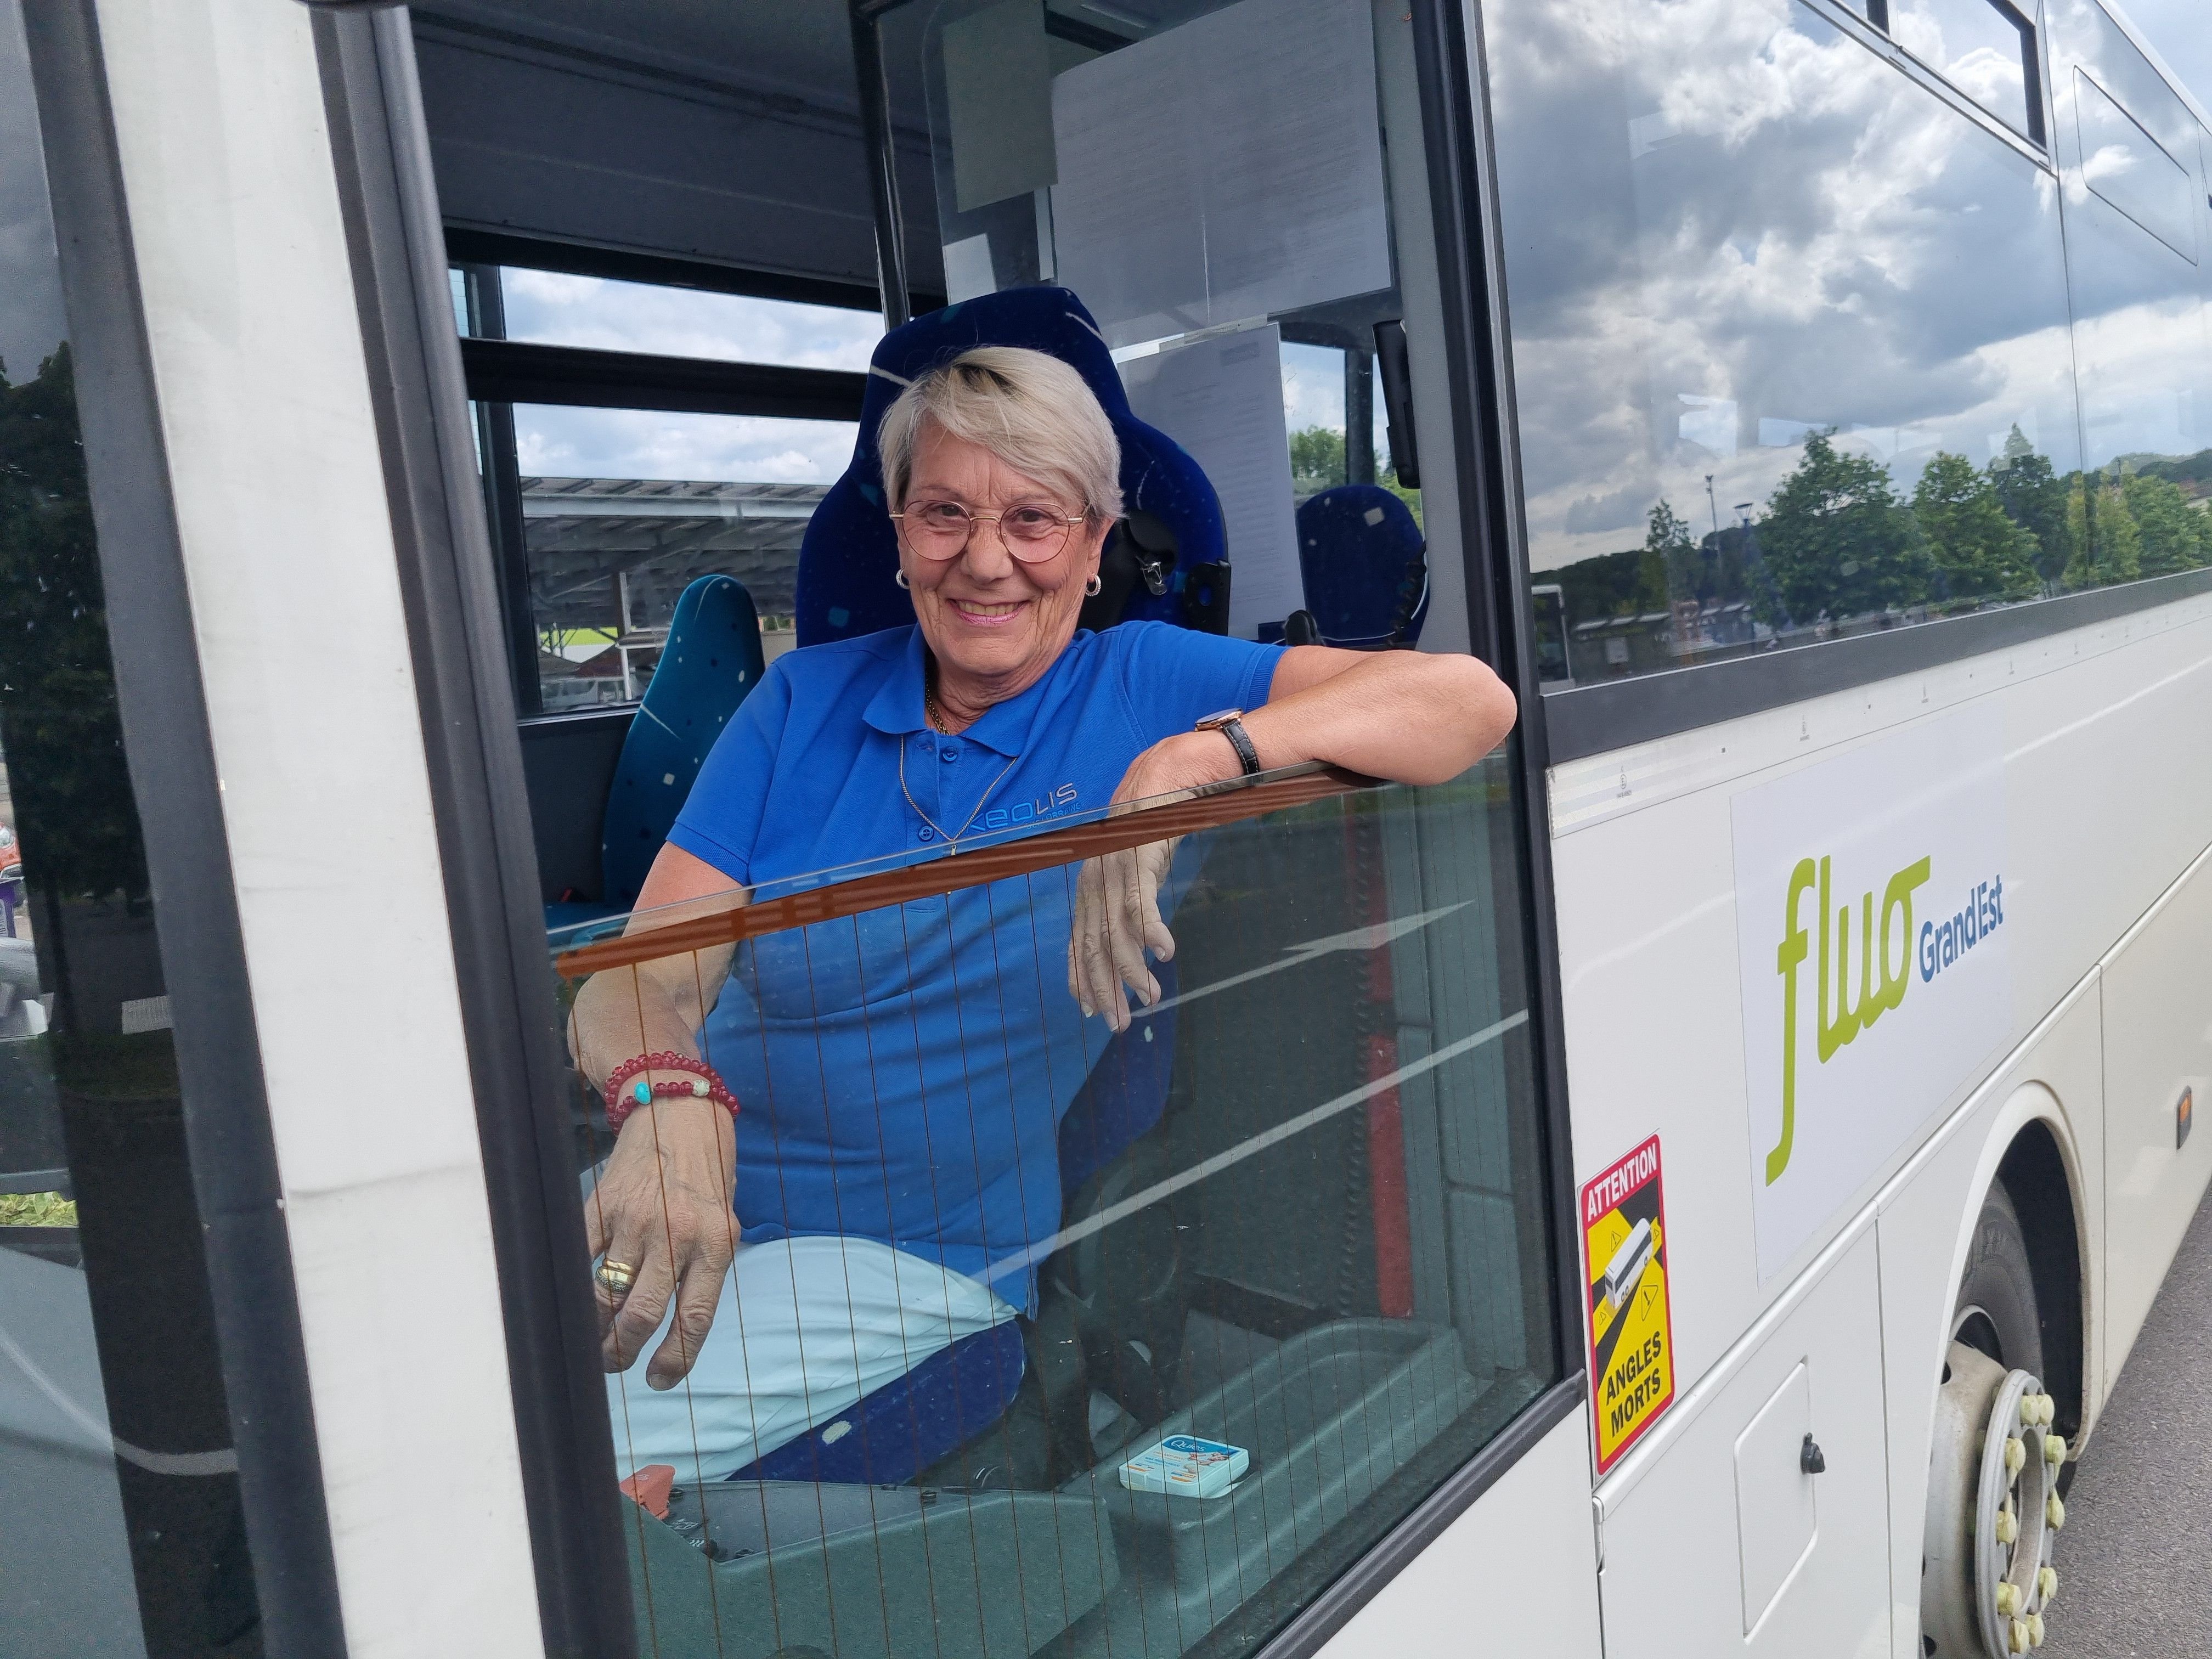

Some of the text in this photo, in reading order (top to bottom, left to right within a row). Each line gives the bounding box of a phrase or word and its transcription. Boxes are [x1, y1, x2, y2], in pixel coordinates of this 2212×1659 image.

[1765, 854, 1931, 1187] fluo
[1587, 1142, 1657, 1223] ATTENTION
[1606, 1330, 1661, 1406] ANGLES
[1610, 1367, 1661, 1437] MORTS
